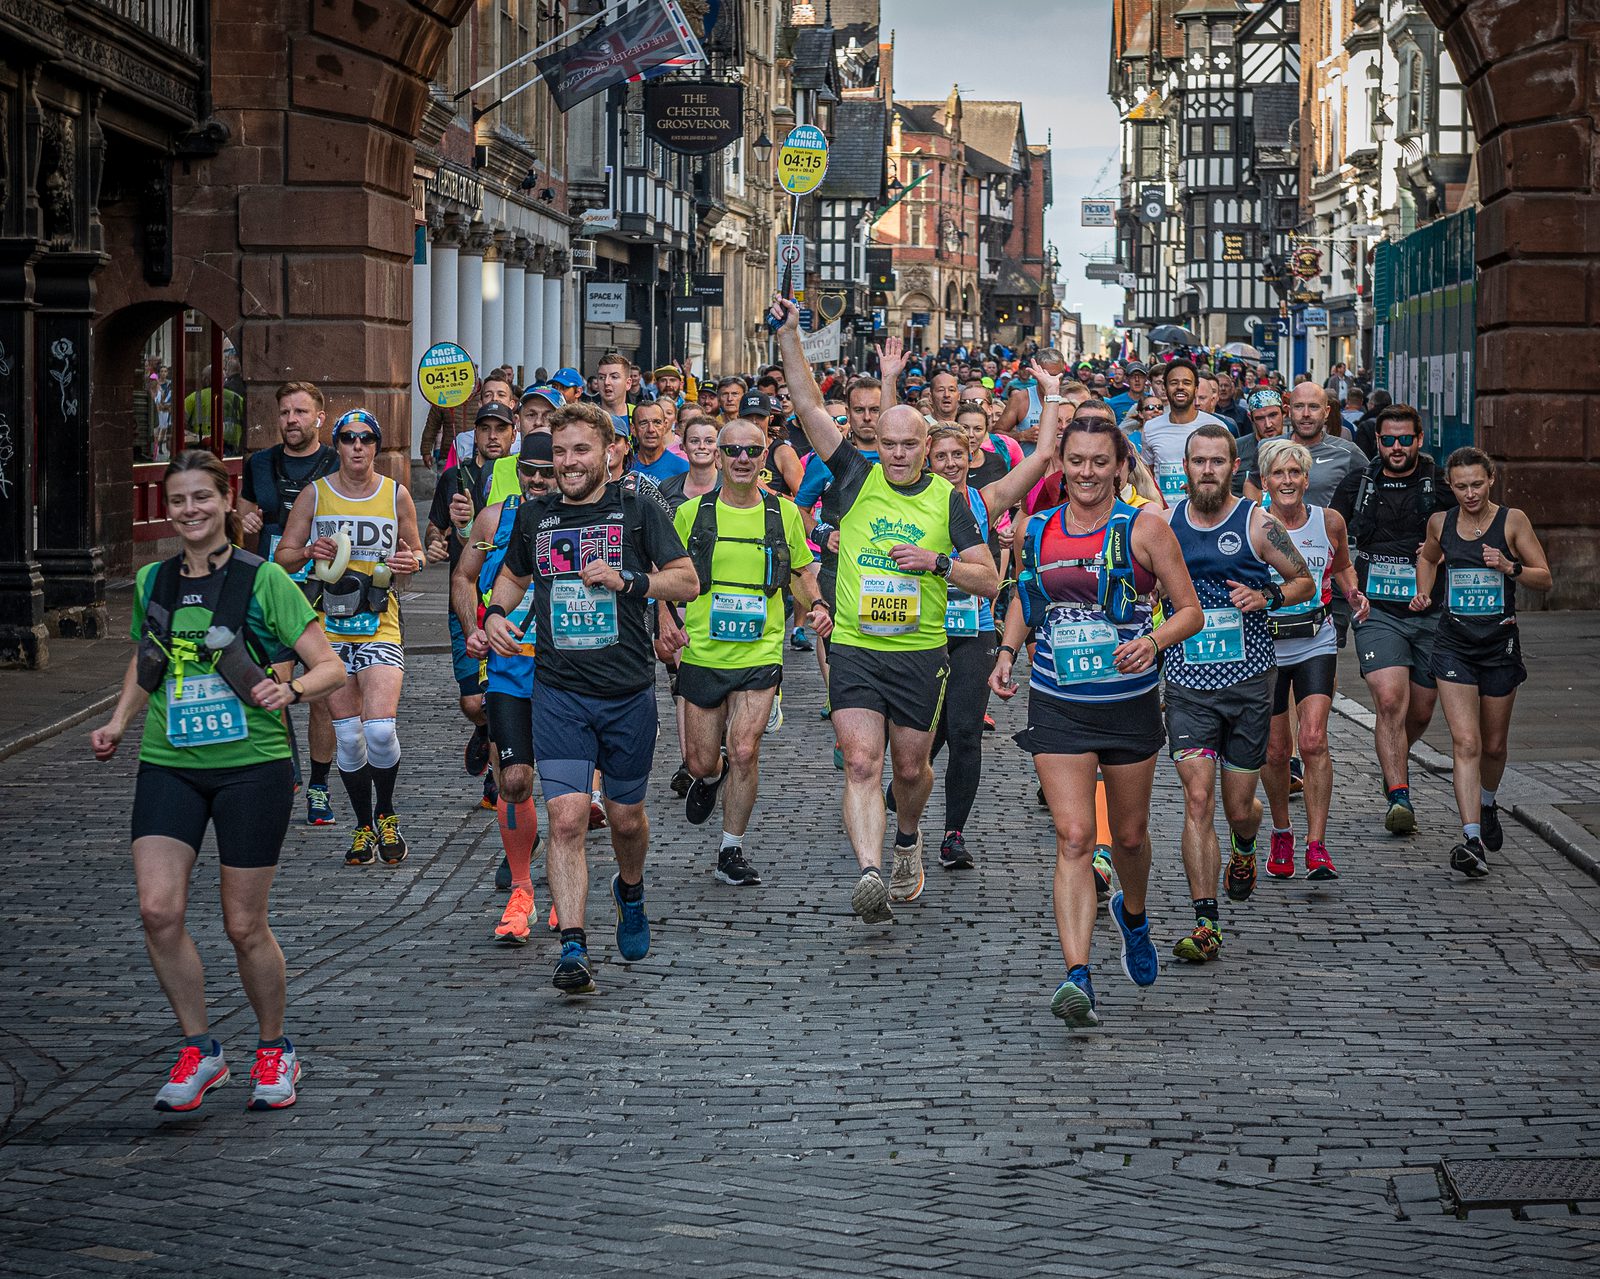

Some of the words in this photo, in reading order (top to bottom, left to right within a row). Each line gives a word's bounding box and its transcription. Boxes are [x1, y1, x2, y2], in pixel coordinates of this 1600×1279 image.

[681, 94, 707, 104] THE
[667, 106, 720, 116] CHESTER
[657, 119, 731, 129] GROSVENOR
[796, 131, 818, 140] PACE
[788, 138, 822, 149] RUNNER
[783, 154, 822, 168] 04:15
[431, 347, 457, 357] PACE
[425, 354, 465, 367] RUNNER
[426, 369, 469, 385] 04:15
[1165, 480, 1185, 490] 612
[861, 557, 884, 567] PACE
[1373, 554, 1410, 564] SUNDRIED
[864, 578, 885, 586] mbna
[1375, 584, 1409, 596] 1048
[568, 600, 596, 611] ALEX
[871, 598, 908, 610] PACER
[1458, 595, 1496, 607] 1278
[560, 612, 606, 627] 3062
[871, 610, 907, 622] 04:15
[718, 620, 756, 633] 3075
[1057, 629, 1076, 637] mbna
[1196, 639, 1226, 654] 171
[1067, 655, 1103, 672] 169
[181, 703, 227, 715] ALEXANDRA
[178, 712, 233, 734] 1369
